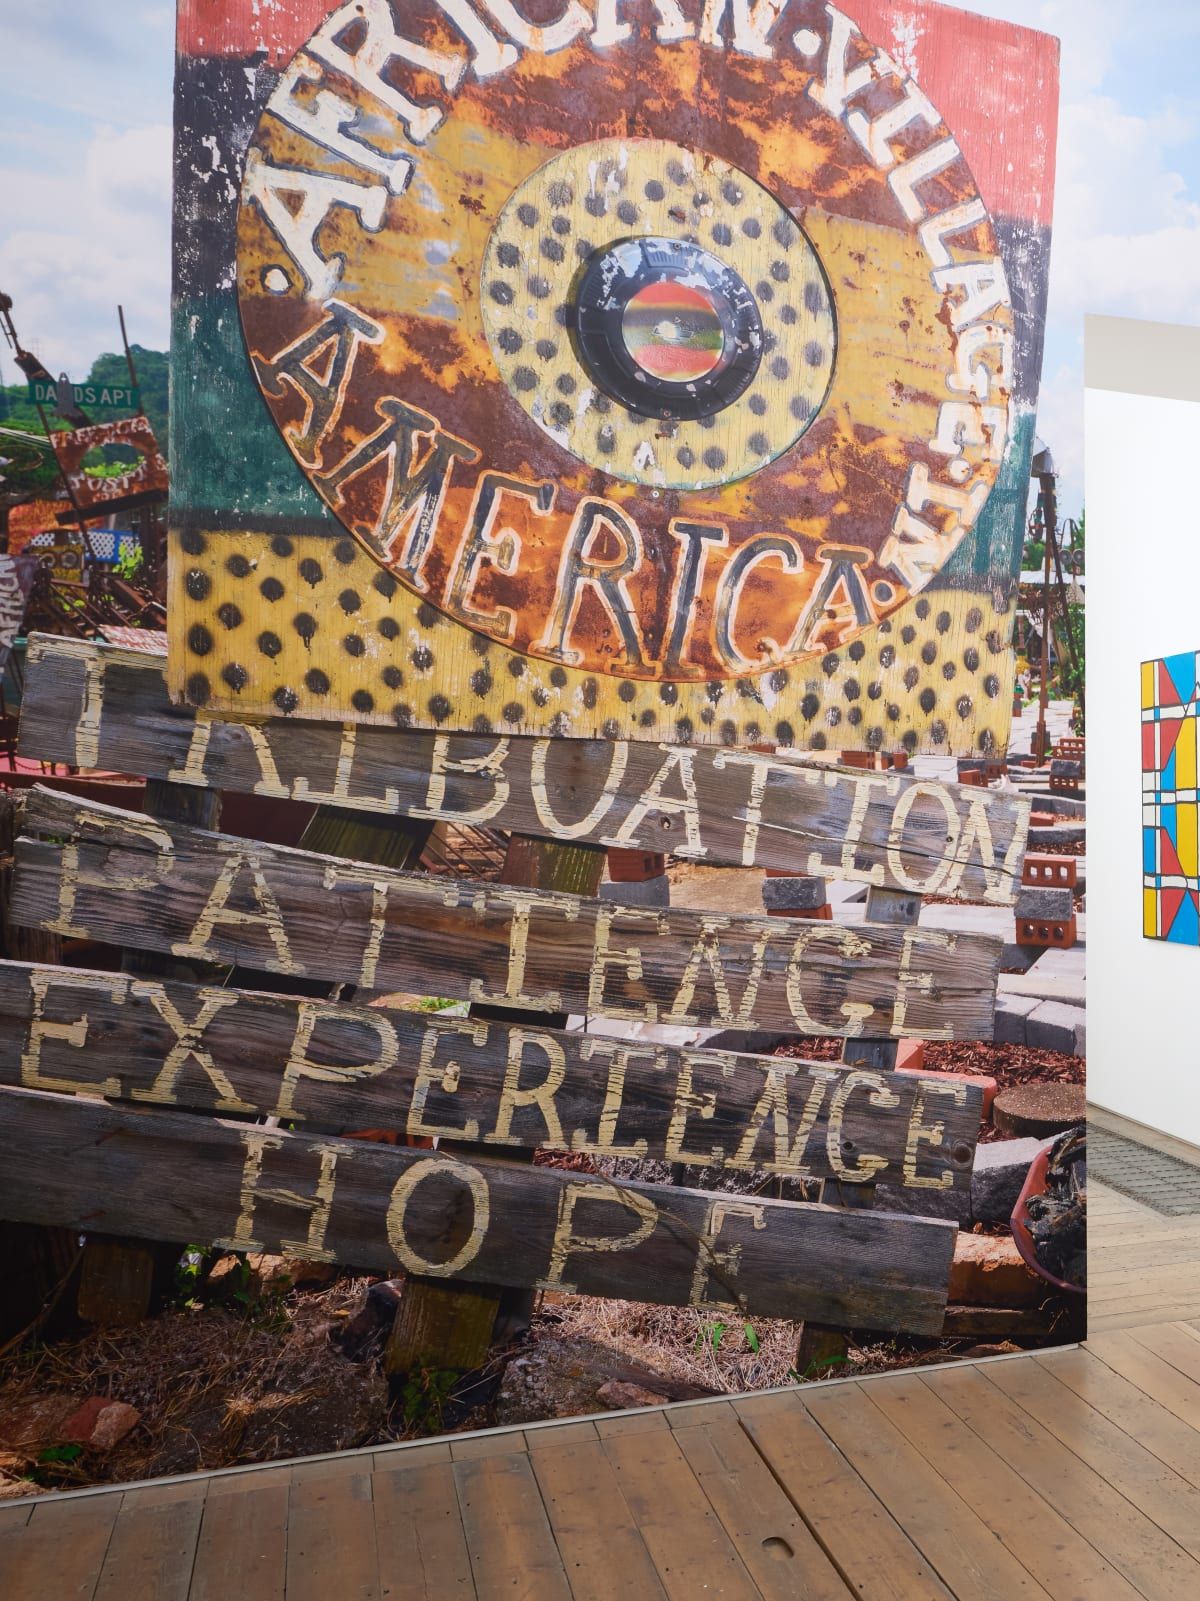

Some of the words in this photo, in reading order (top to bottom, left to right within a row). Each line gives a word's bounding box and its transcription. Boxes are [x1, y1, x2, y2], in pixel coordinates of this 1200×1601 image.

[805, 2, 1013, 463] VILLAGE
[35, 384, 97, 404] DADS
[100, 388, 134, 406] APT
[250, 298, 880, 678] AMERICA
[879, 463, 989, 597] IN
[42, 811, 957, 1041] PATIENCE
[20, 967, 966, 1189] EXPERIENCE
[213, 1132, 766, 1310] HOPE
